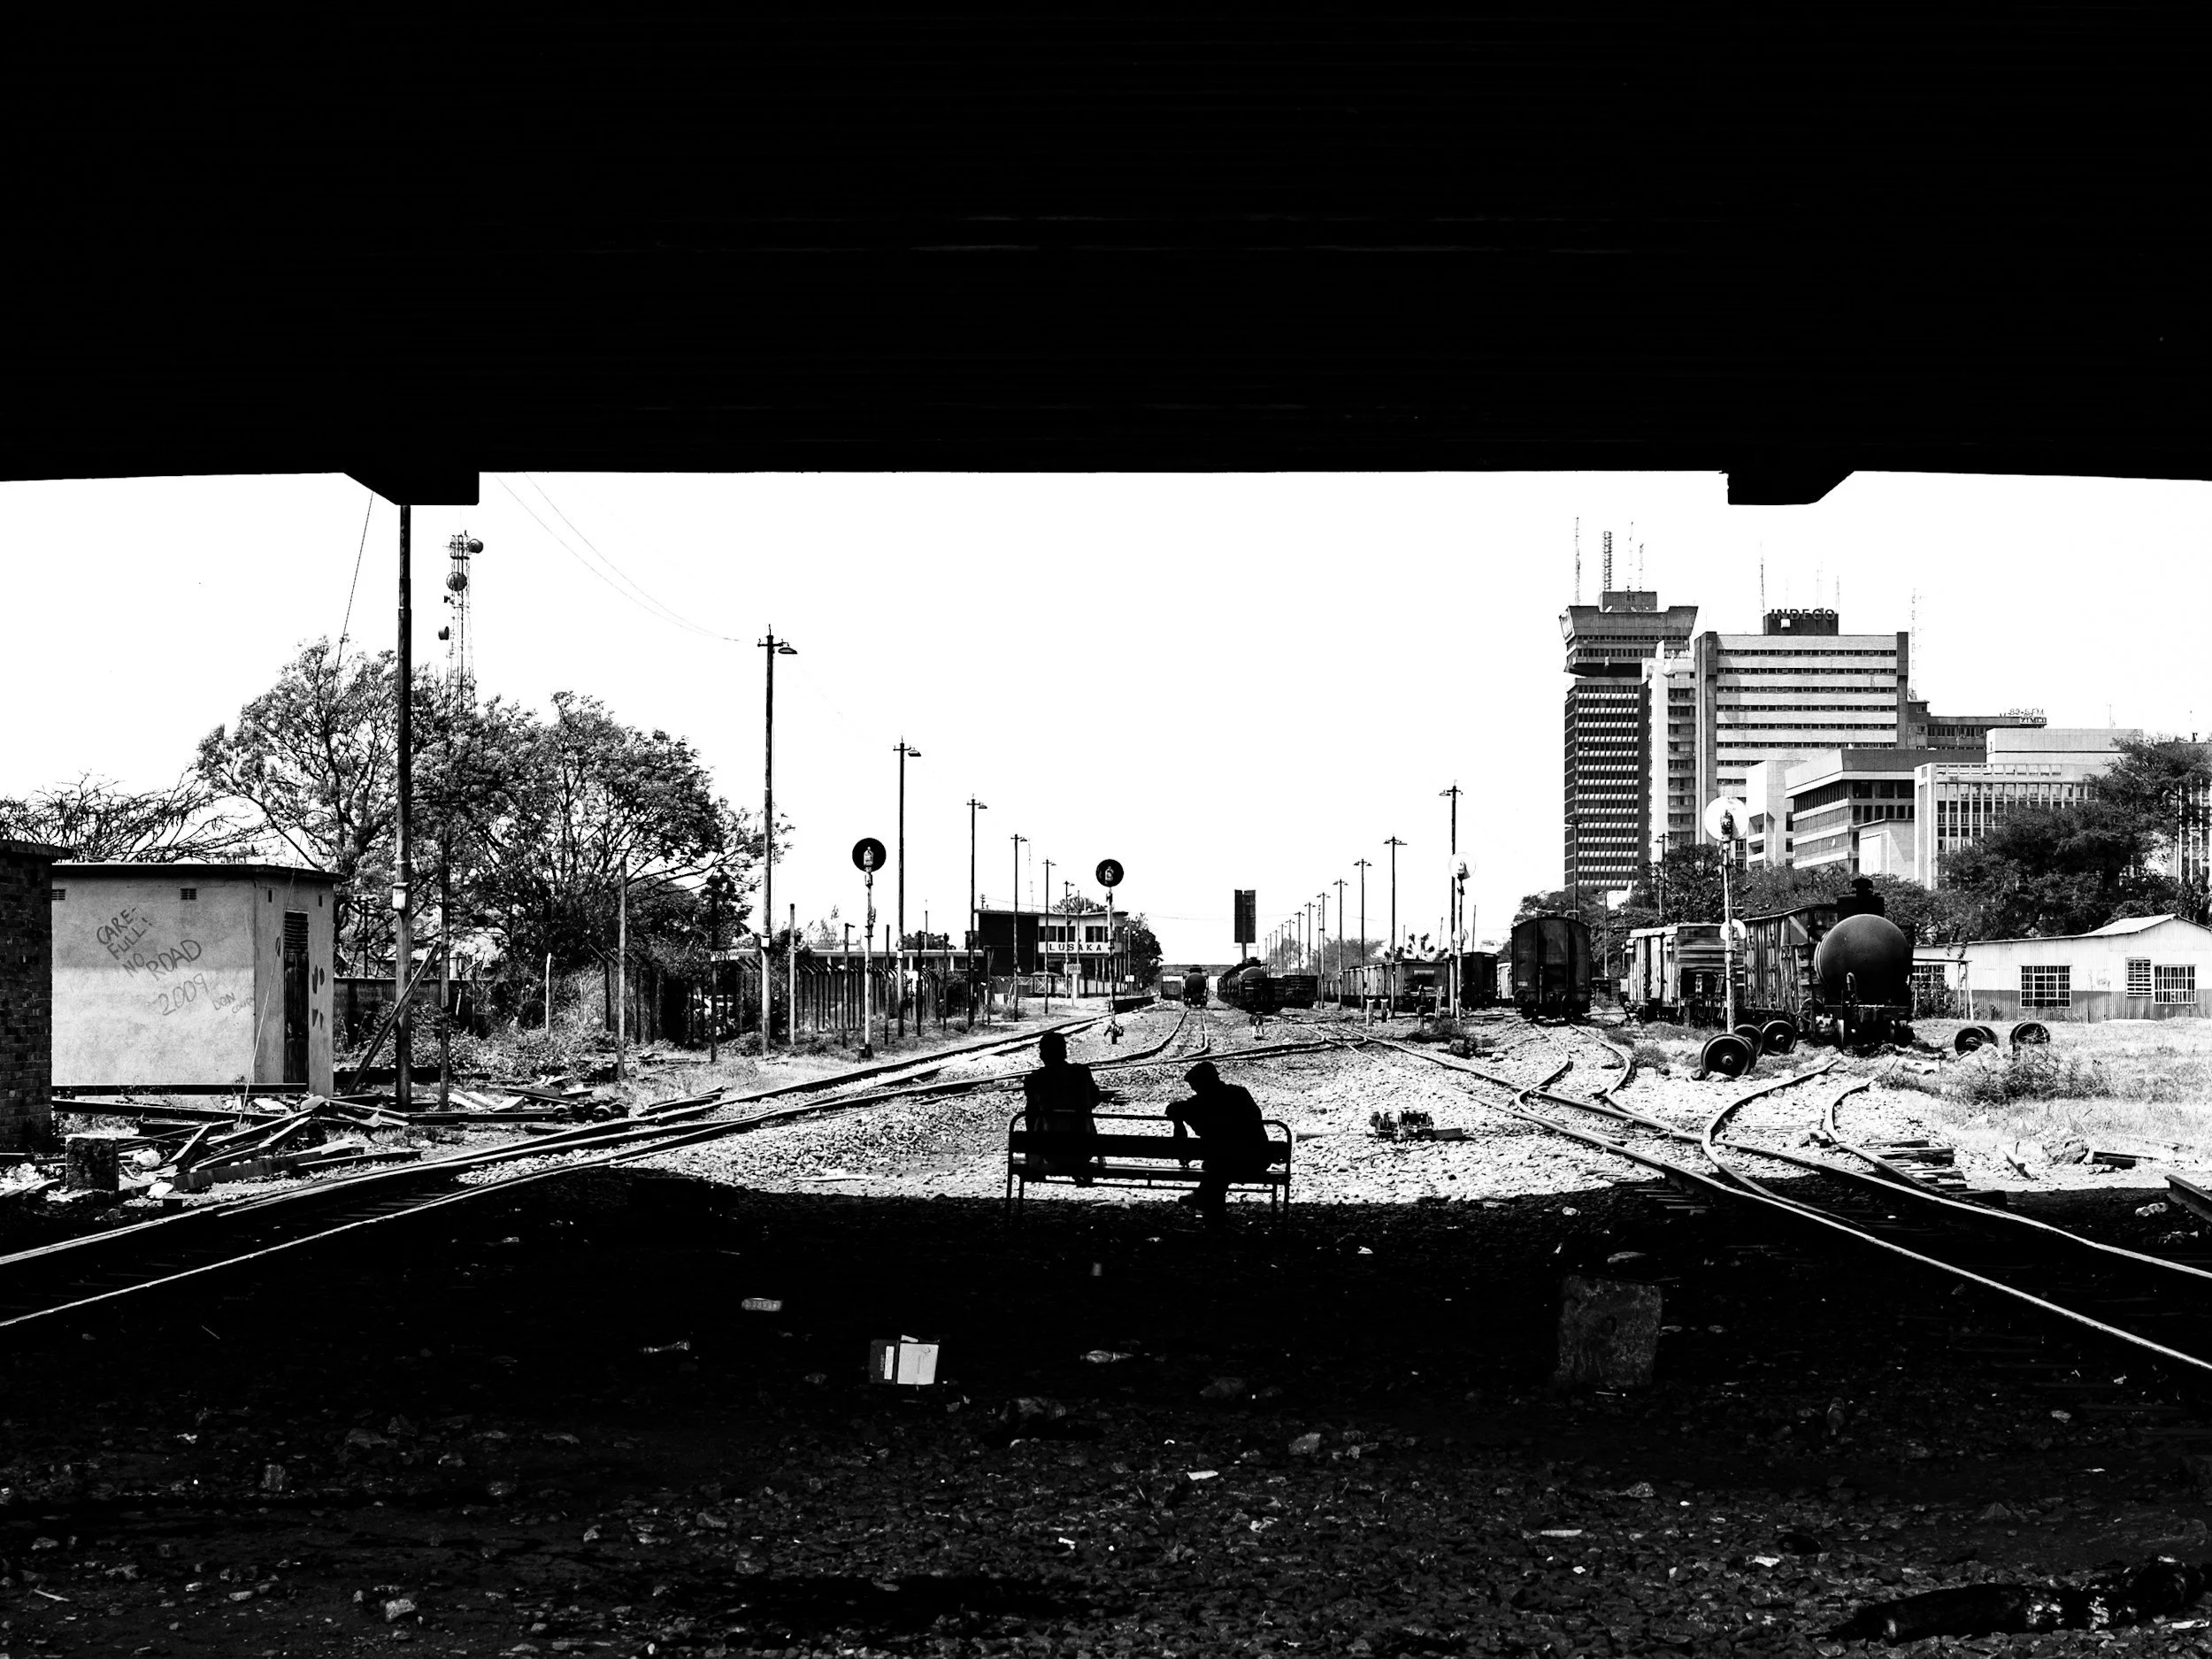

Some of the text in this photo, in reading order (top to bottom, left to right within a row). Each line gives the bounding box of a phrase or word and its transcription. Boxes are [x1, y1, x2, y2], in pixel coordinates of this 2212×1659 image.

[1770, 608, 1836, 620] INDECO
[122, 939, 202, 982] NO ROAD
[158, 972, 210, 1016] 2009
